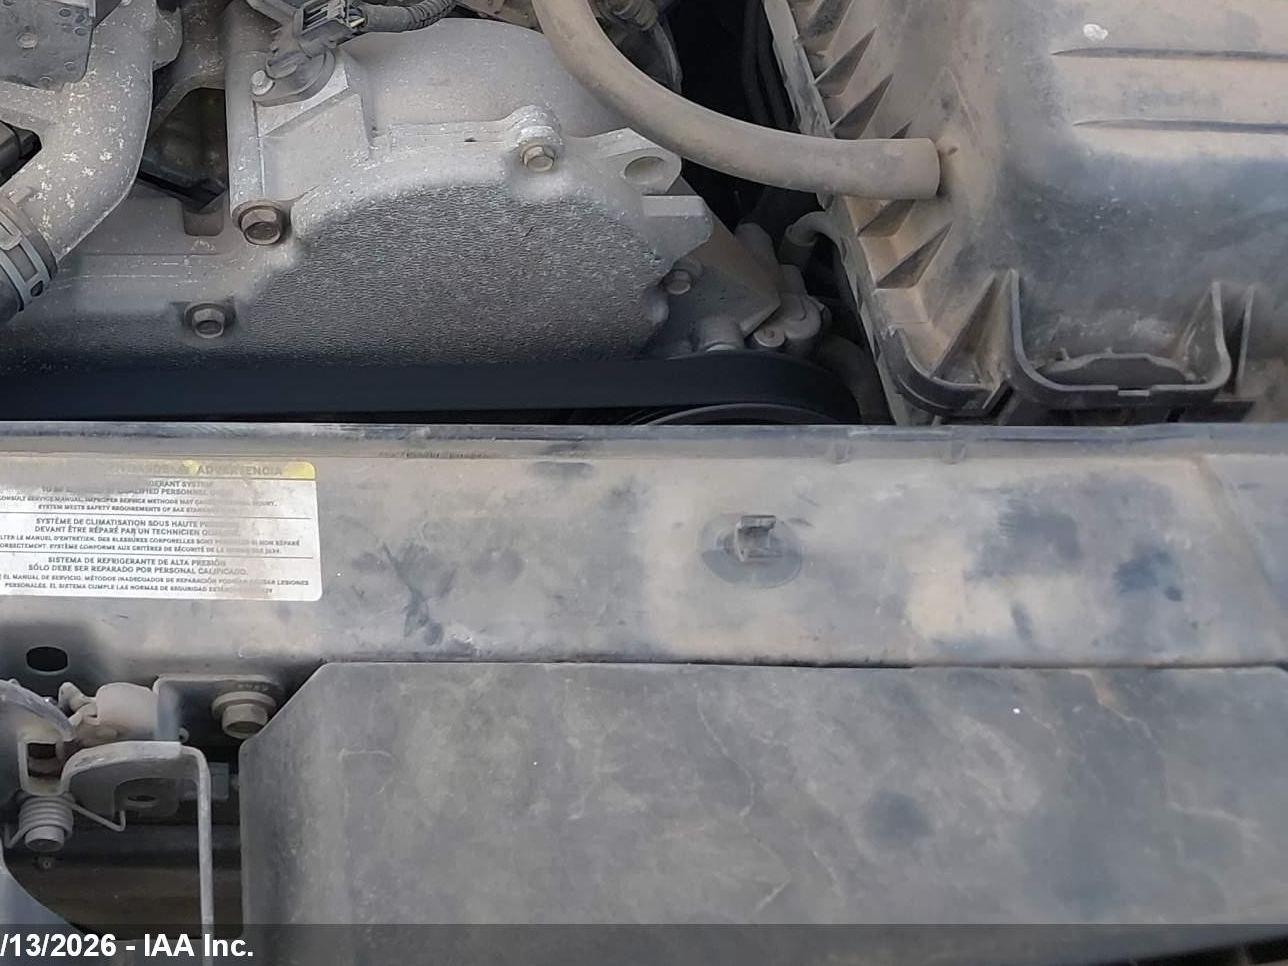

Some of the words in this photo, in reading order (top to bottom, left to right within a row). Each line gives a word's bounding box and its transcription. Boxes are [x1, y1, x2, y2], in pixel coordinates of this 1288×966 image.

[35, 516, 72, 526] SYSTÈME
[73, 518, 85, 526] DE
[86, 518, 146, 527] CLIMATISATION
[171, 520, 197, 528] HAUTE
[35, 525, 66, 533] DEVANT
[67, 524, 87, 534] ÊTRE
[88, 525, 119, 535] RÉPARÉ
[120, 527, 137, 535] PAR
[137, 527, 149, 535] UN
[151, 528, 200, 536] TECHNICIEN
[47, 556, 83, 565] SISTEMA
[83, 557, 95, 566] DE
[96, 557, 157, 567] REFRIGERANTE
[157, 559, 170, 567] DE
[170, 559, 190, 567] ALTA
[28, 563, 50, 572] SÓLO
[51, 564, 72, 572] DEBE
[73, 564, 89, 572] SER
[90, 564, 134, 574] REPARADO
[135, 565, 153, 574] POR
[154, 566, 196, 574] PERSONAL
[198, 567, 249, 576] CALIFICADO.
